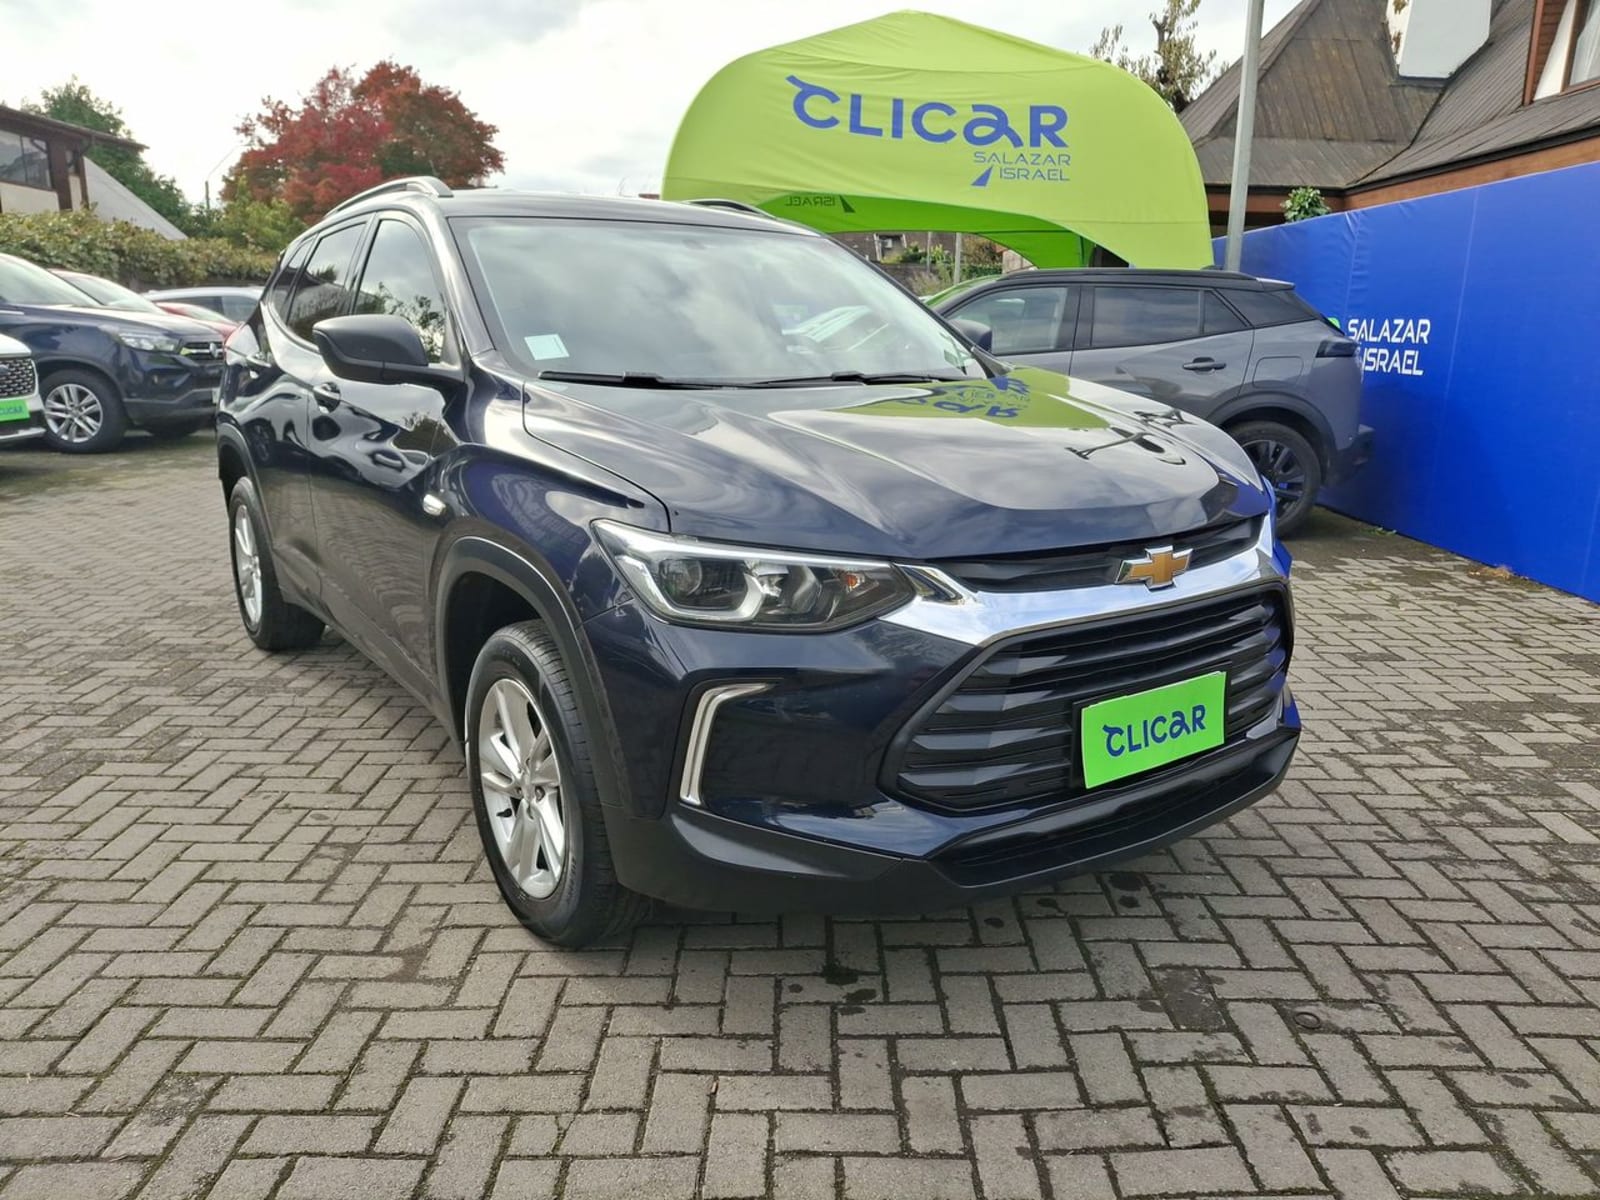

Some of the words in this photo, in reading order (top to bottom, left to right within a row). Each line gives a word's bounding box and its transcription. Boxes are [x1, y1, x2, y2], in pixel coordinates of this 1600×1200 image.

[973, 151, 1071, 166] SALAZAR
[999, 167, 1070, 182] ISRAEL
[1347, 318, 1431, 344] SALAZAR
[1361, 347, 1424, 376] ISRAEL
